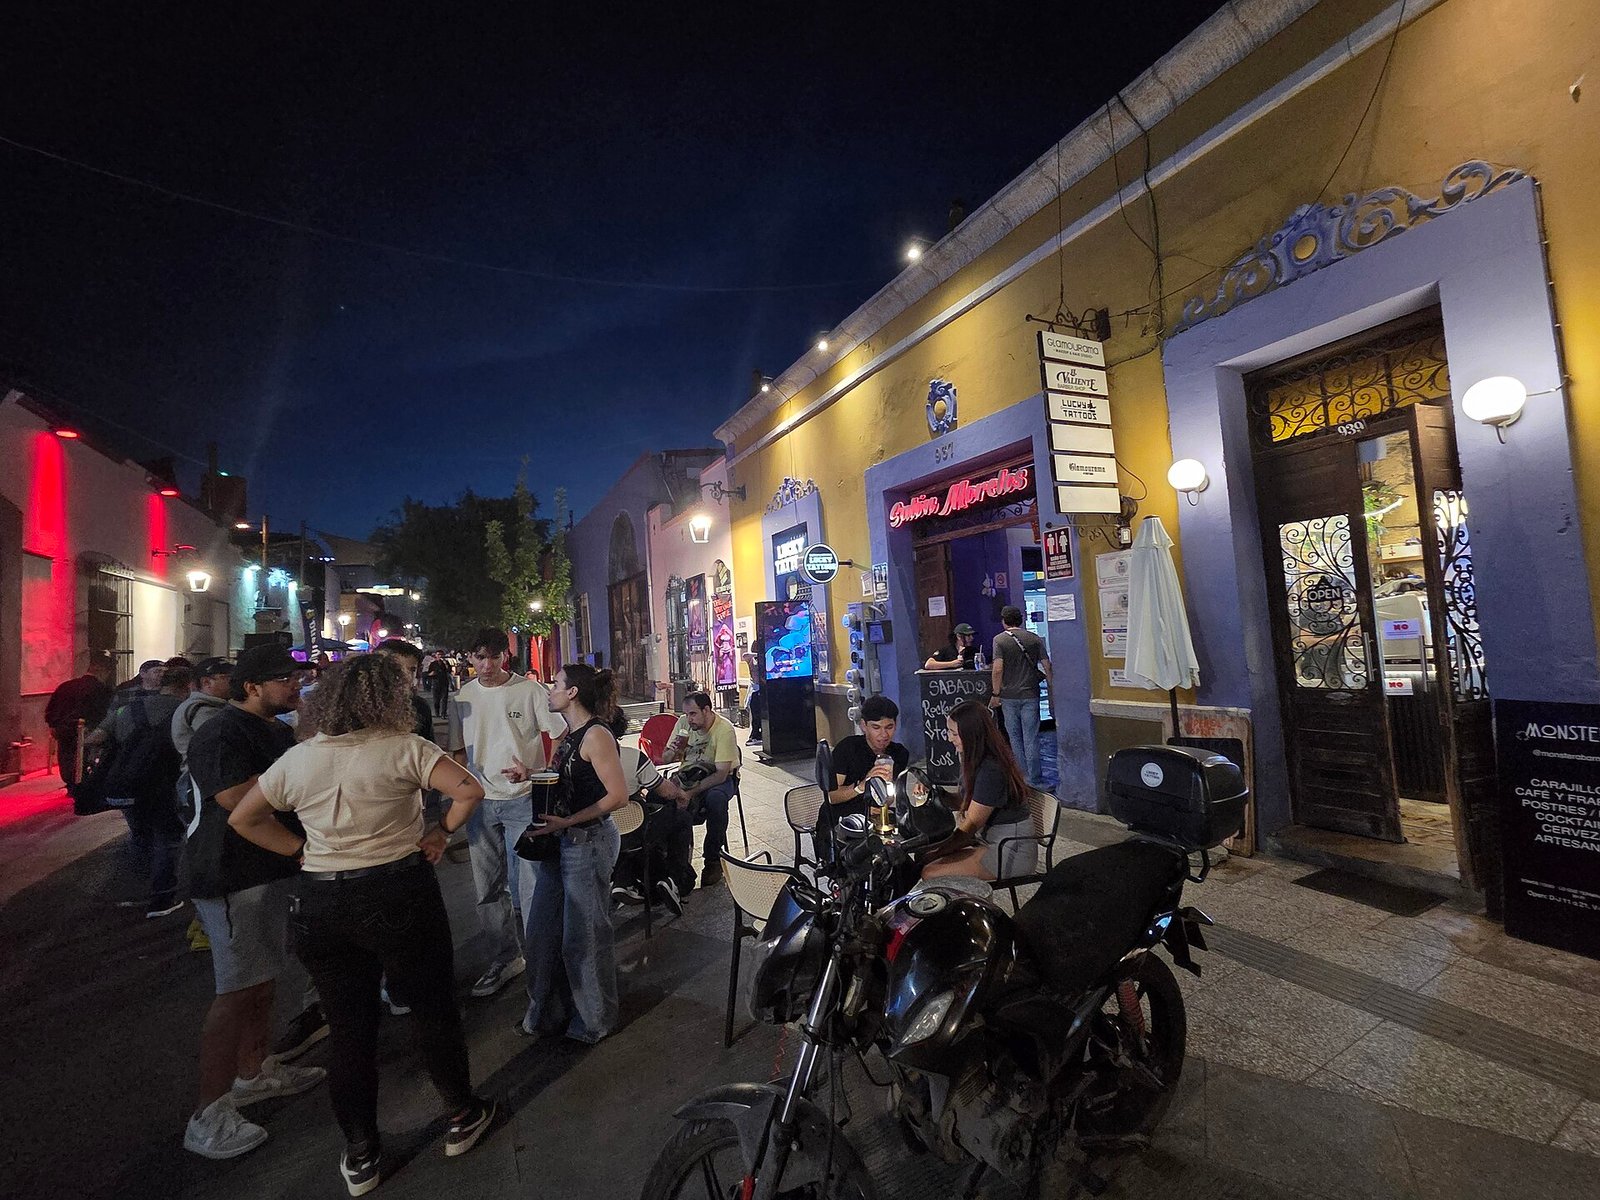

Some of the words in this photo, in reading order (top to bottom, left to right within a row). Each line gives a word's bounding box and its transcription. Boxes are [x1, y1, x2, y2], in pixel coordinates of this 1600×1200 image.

[1056, 371, 1099, 392] VALIENTE
[1063, 409, 1098, 421] TATTOOS
[1337, 421, 1365, 437] 939
[938, 468, 1028, 516] Morelos
[1308, 588, 1341, 601] OPEN
[1525, 722, 1600, 743] MONSTE
[1554, 792, 1565, 801] Y
[1521, 799, 1588, 816] POSTRES
[1535, 812, 1600, 830] COCKTAI
[1541, 824, 1600, 842] CERVEZ
